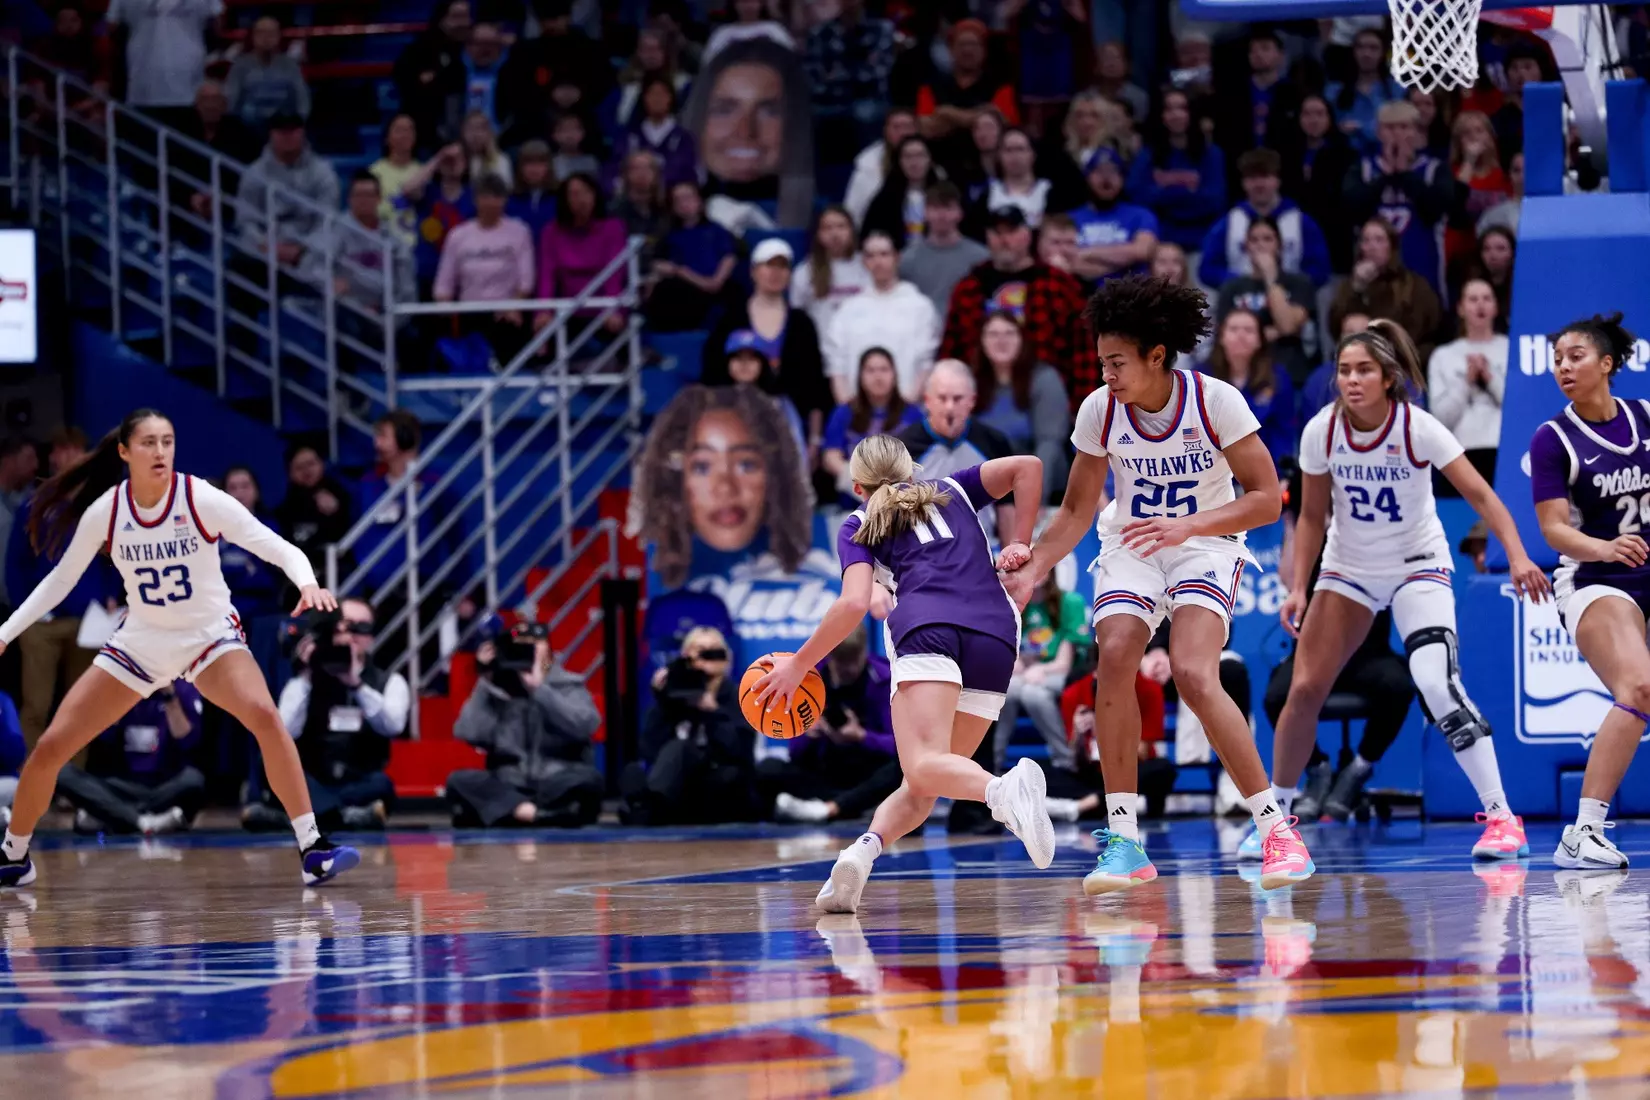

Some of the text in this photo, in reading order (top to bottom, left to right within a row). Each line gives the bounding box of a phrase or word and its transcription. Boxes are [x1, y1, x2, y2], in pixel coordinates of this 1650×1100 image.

[1131, 478, 1199, 518] 25
[1344, 485, 1403, 522] 24
[119, 537, 199, 562] JAYHAWKS
[134, 564, 193, 606] 23
